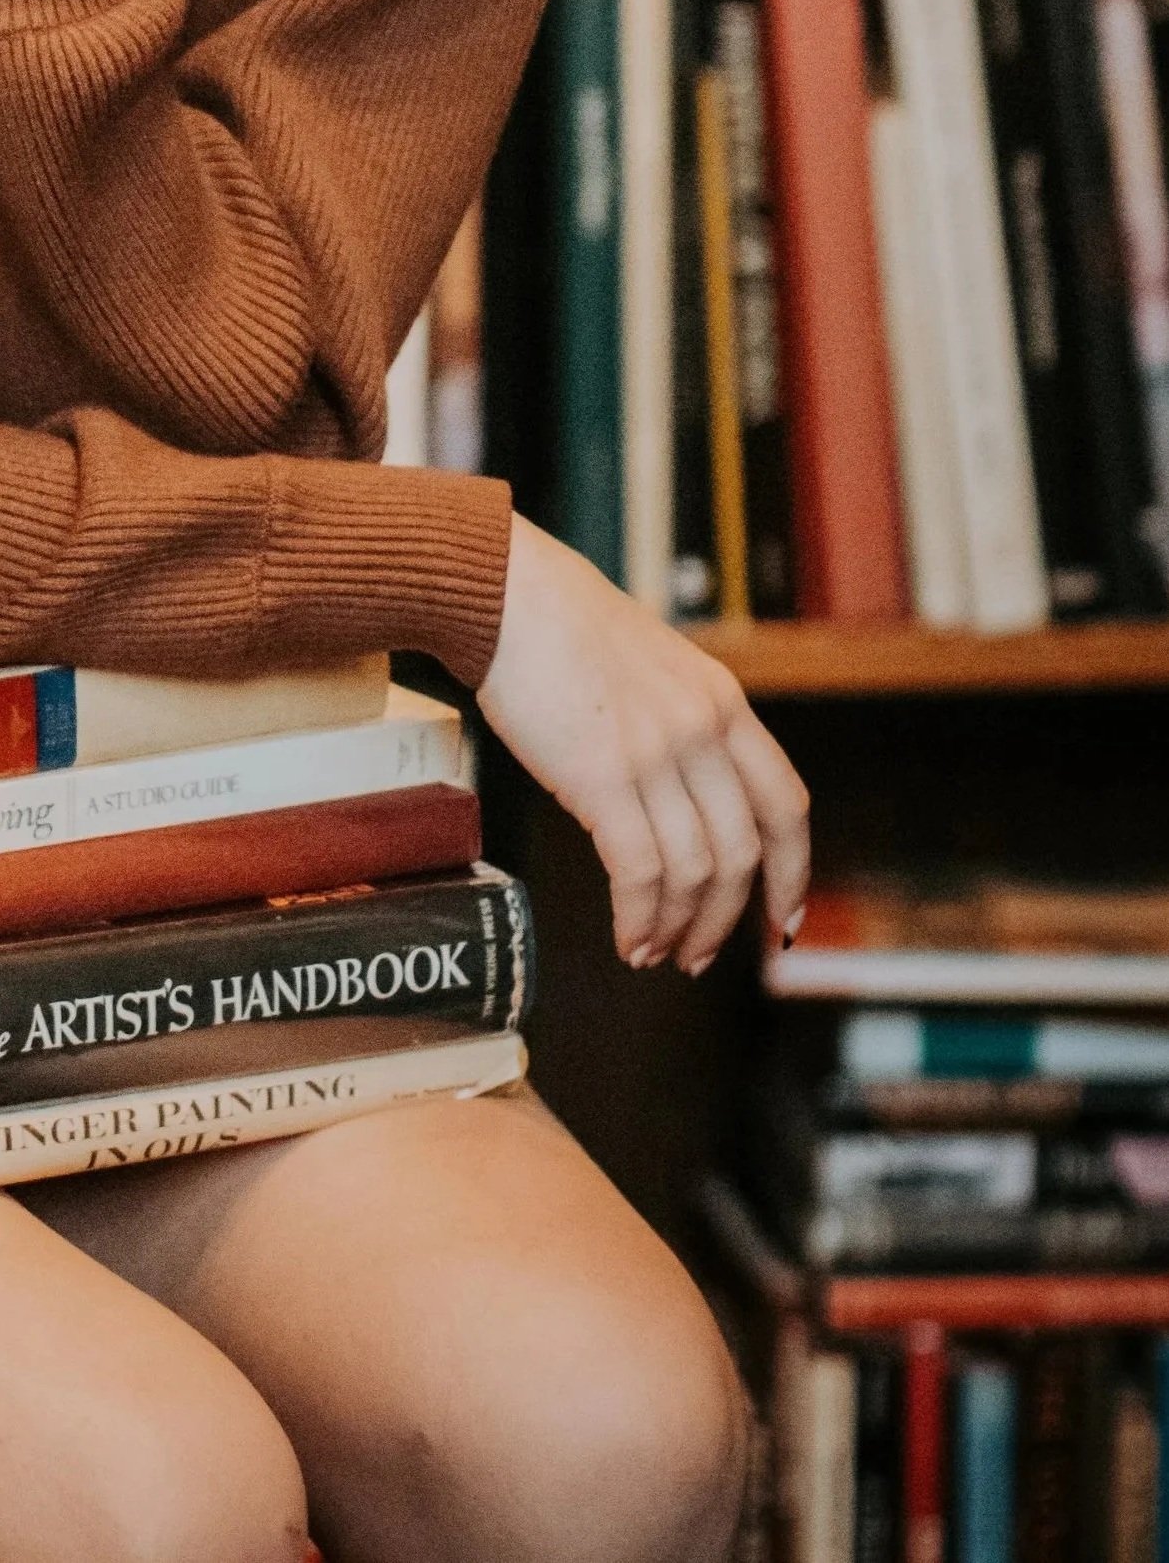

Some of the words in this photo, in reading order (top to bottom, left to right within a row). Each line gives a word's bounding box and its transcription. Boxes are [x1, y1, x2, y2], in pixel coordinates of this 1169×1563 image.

[87, 796, 100, 816] A
[103, 783, 177, 813] STUDIO
[181, 773, 240, 801] GUIDE
[20, 977, 196, 1054] ARTIST'S
[210, 940, 472, 1026] HANDBOOK
[156, 1072, 357, 1130] PAINTING
